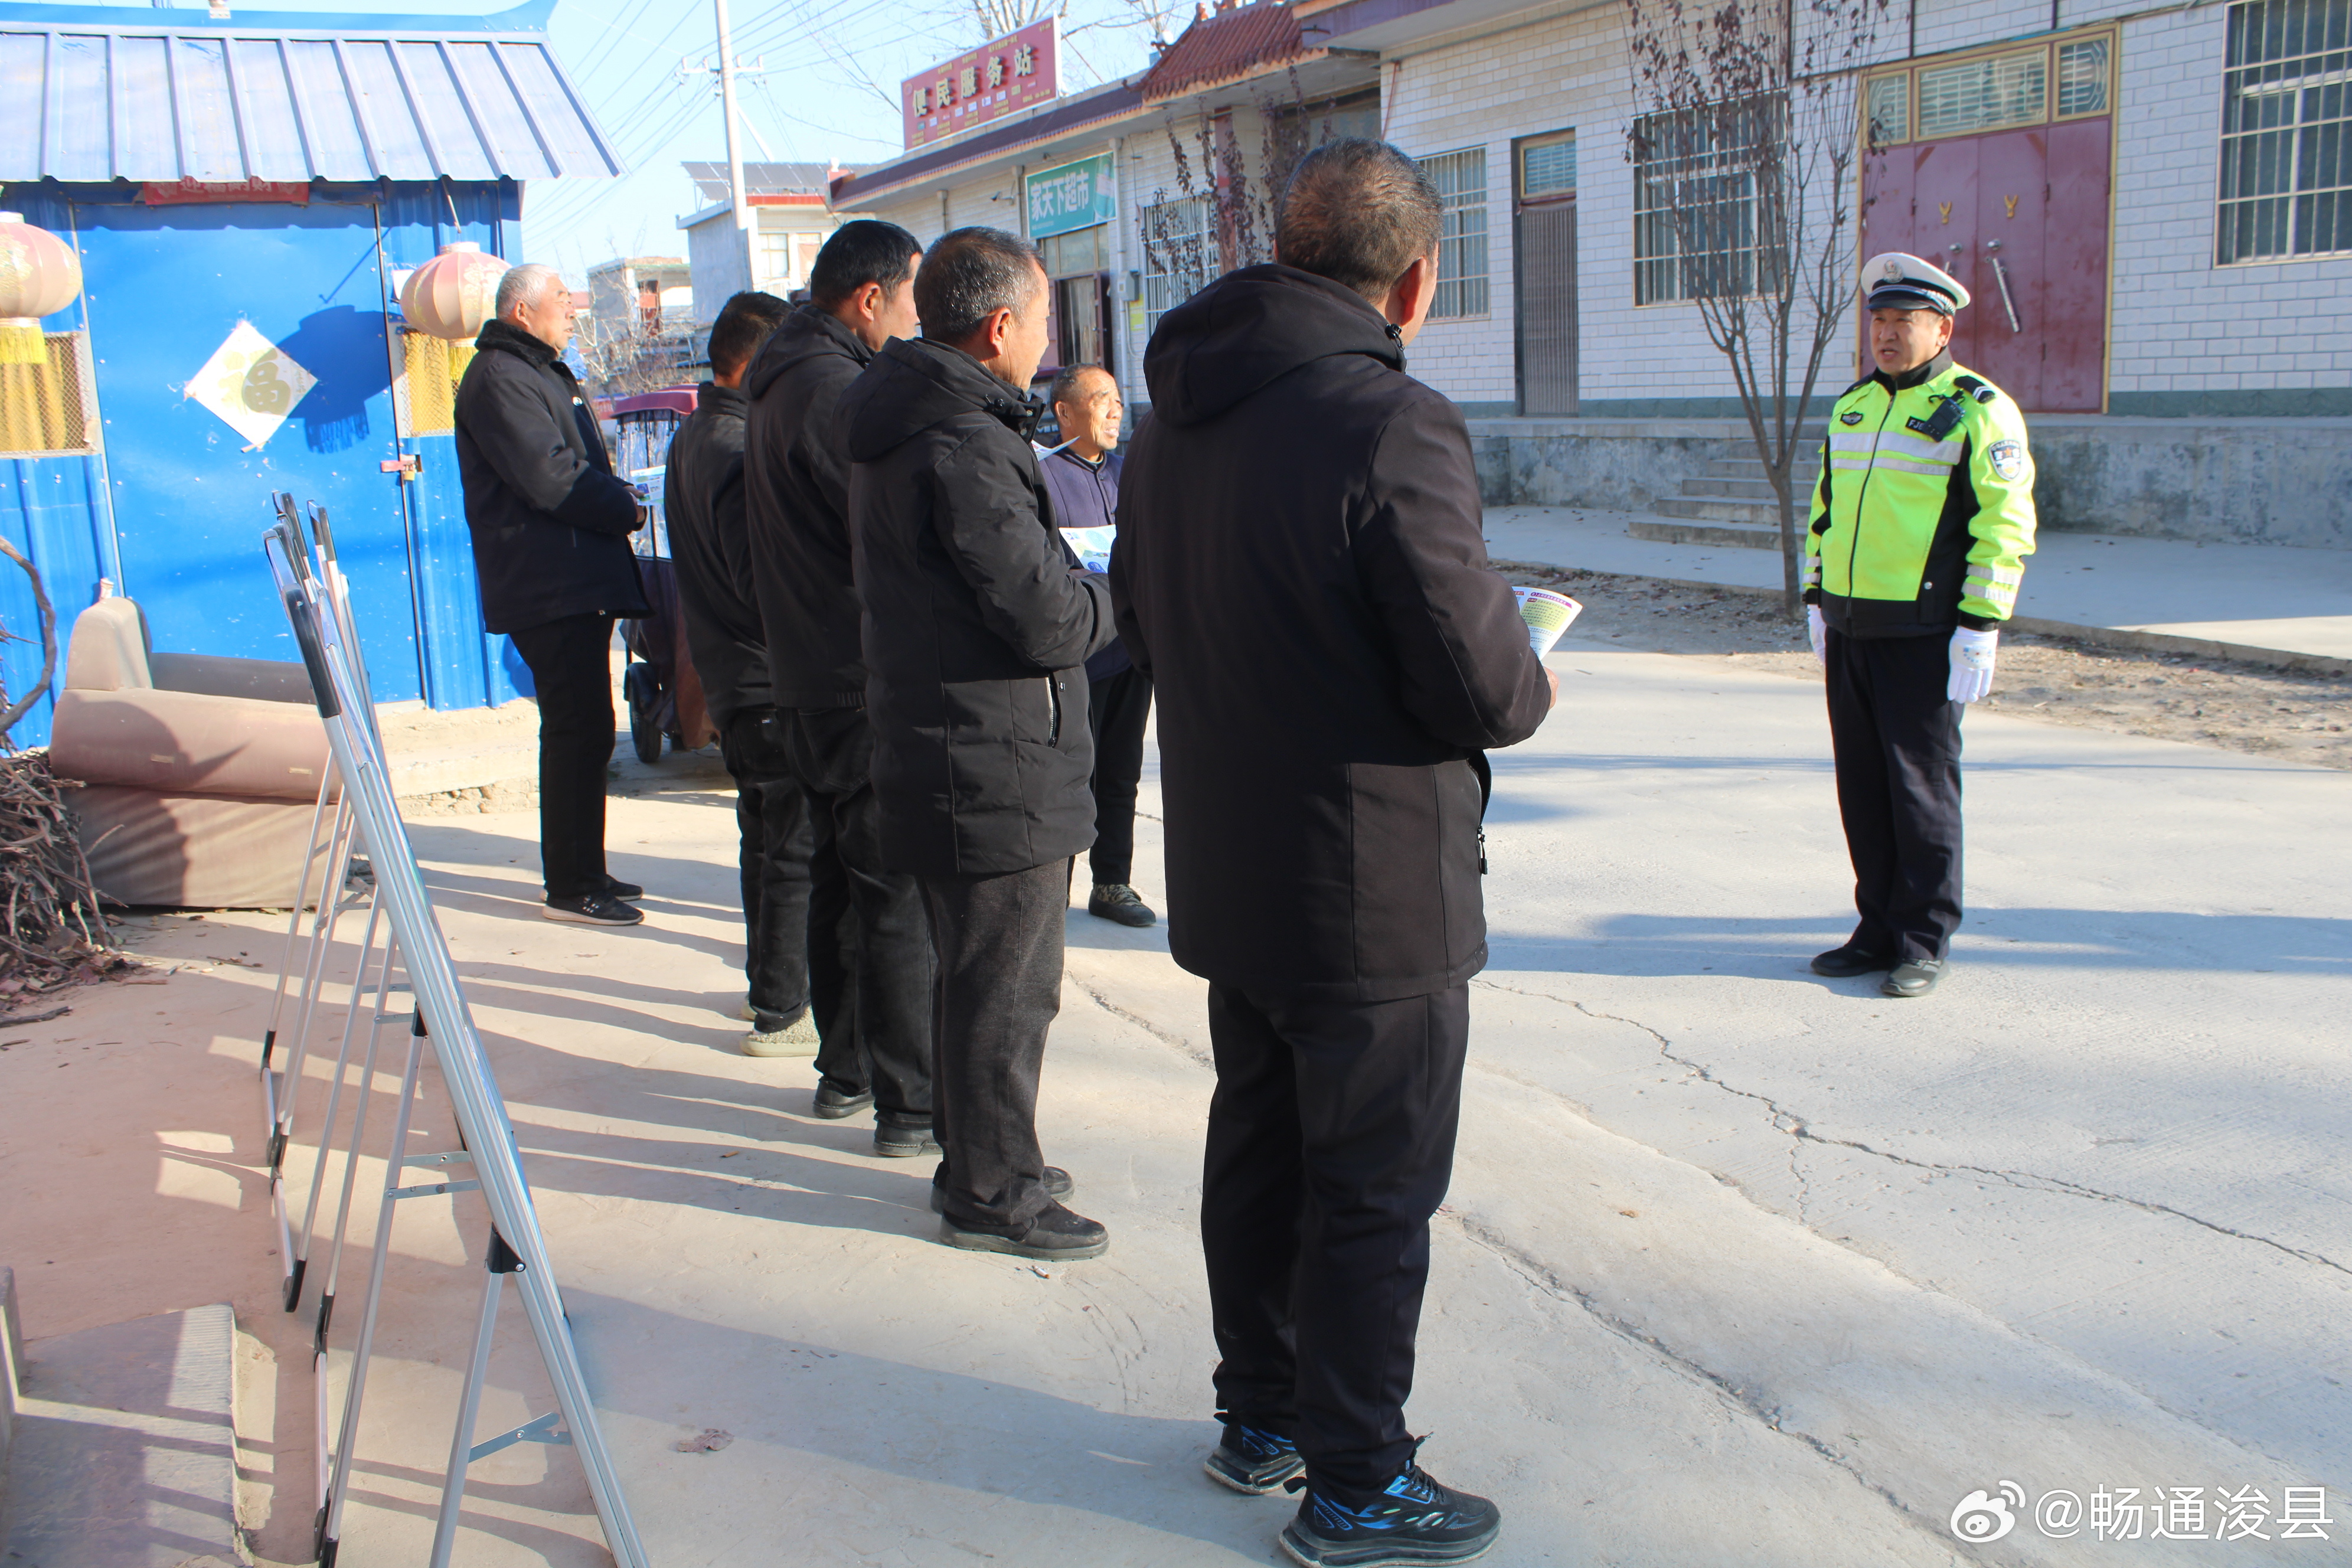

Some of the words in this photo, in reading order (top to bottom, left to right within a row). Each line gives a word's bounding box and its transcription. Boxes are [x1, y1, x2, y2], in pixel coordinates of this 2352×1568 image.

[913, 43, 1031, 117] 便民服务站
[1030, 168, 1089, 221] 家天下超市
